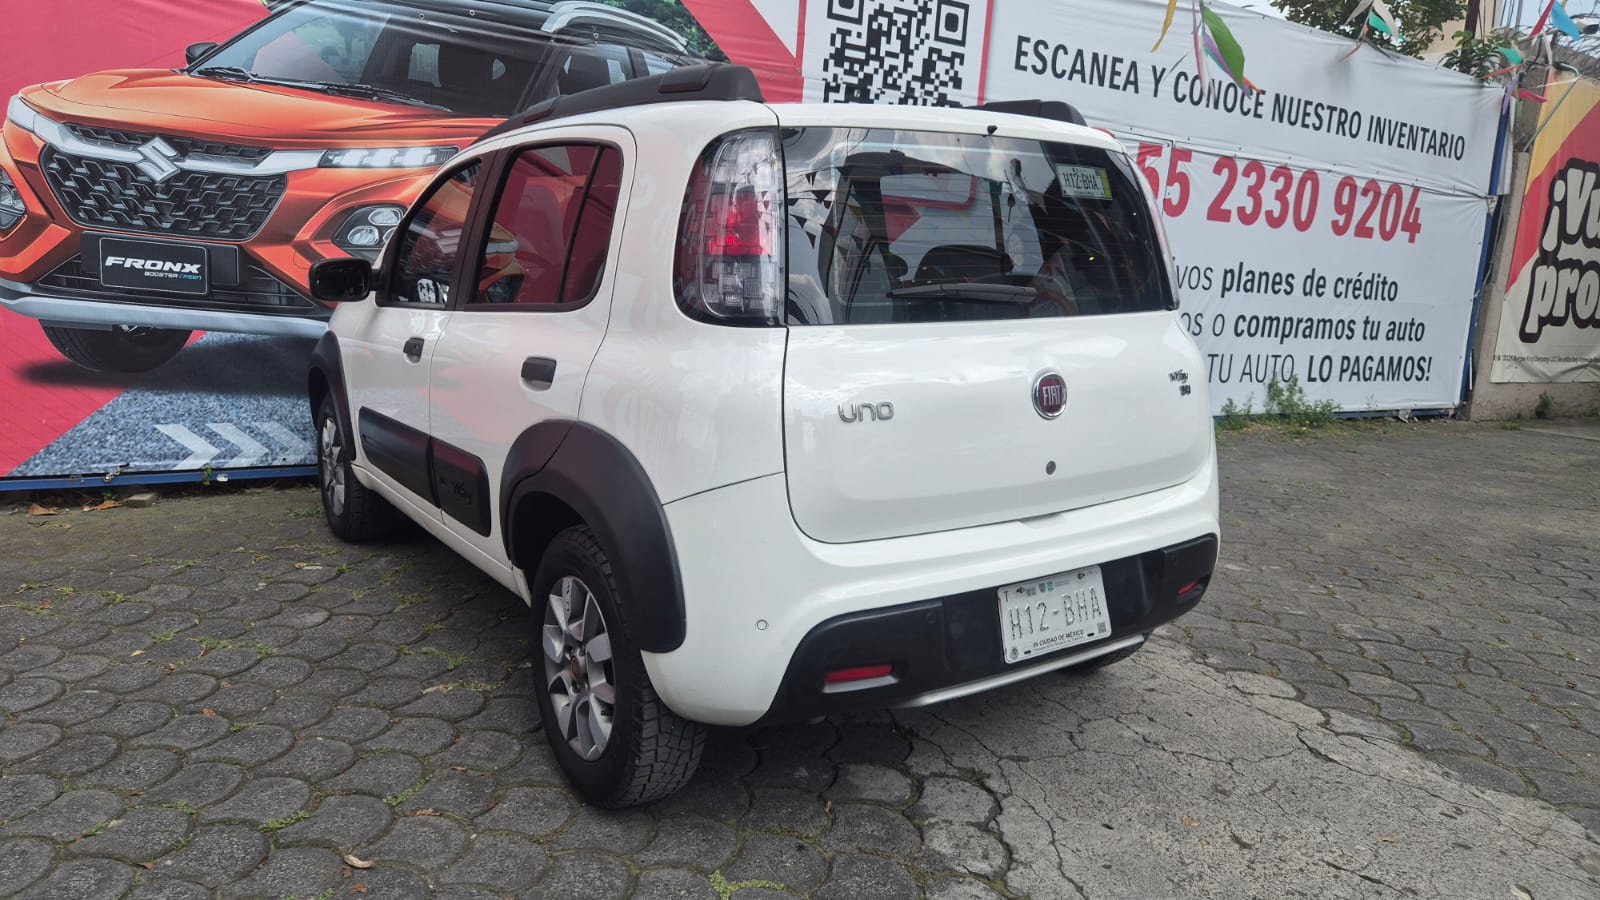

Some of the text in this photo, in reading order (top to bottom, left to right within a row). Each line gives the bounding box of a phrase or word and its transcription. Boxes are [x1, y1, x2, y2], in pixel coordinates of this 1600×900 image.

[1014, 35, 1465, 161] ESCANEA Y CONOCE NUESTRO INVENTARIO
[1133, 143, 1421, 244] 55 2330 9204
[105, 256, 201, 274] FRONX
[144, 271, 178, 279] BOOSTER
[1175, 261, 1398, 302] vos planes de crédito
[1525, 265, 1600, 334] pro
[1180, 312, 1425, 345] os o compramos tu auto
[1207, 353, 1432, 383] TU AUTO LO PAGAMOS!
[1042, 384, 1061, 406] FIAT
[1008, 587, 1102, 640] H12-BHA
[1039, 636, 1057, 646] CIUDAD
[1057, 633, 1065, 641] DE
